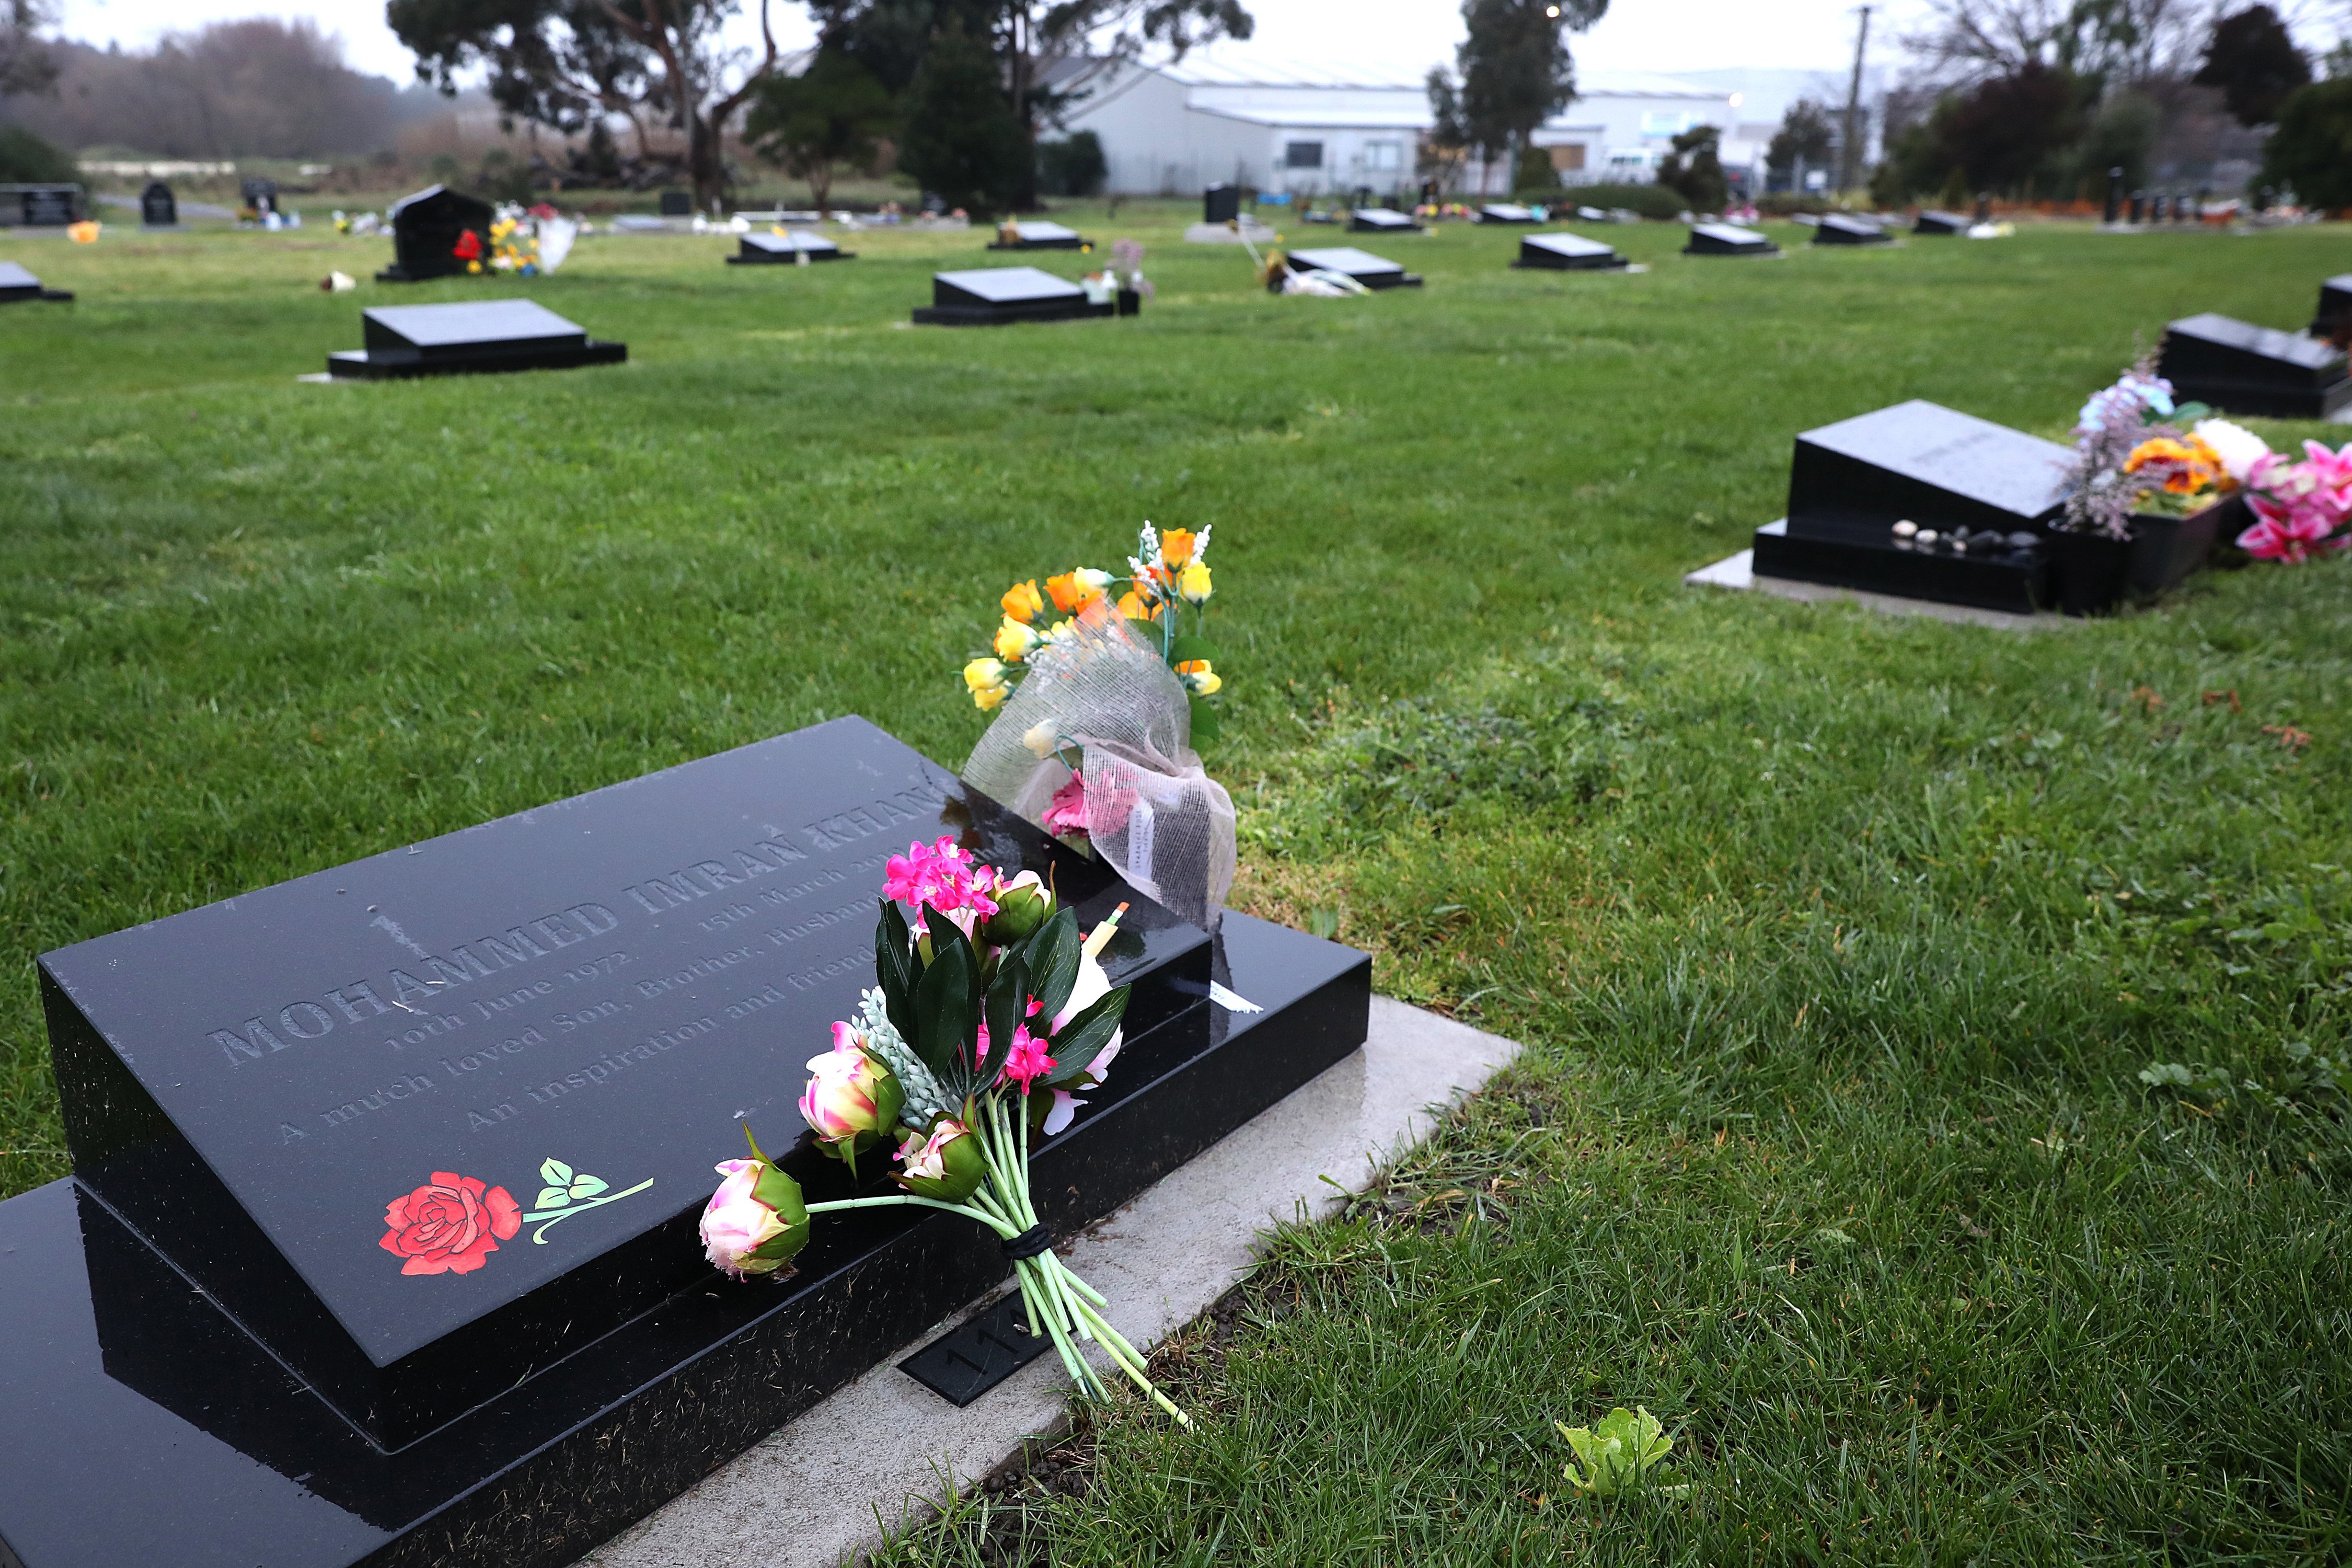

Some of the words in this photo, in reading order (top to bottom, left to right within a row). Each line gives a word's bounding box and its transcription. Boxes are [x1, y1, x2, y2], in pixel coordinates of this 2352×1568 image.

[205, 901, 619, 1068] MOHAMMED
[622, 833, 809, 915] IMRAN
[802, 785, 947, 851] KHAN
[384, 1011, 467, 1051] 10th
[470, 980, 555, 1021] June
[563, 951, 632, 983] 1972
[698, 902, 756, 932] 15th
[758, 868, 847, 907] March
[280, 1121, 312, 1146] A
[320, 1071, 435, 1127] much
[438, 1023, 548, 1077] loved
[551, 998, 633, 1034] Son,
[467, 1101, 522, 1133] An
[524, 1016, 721, 1105] inspiration
[724, 983, 786, 1020] and
